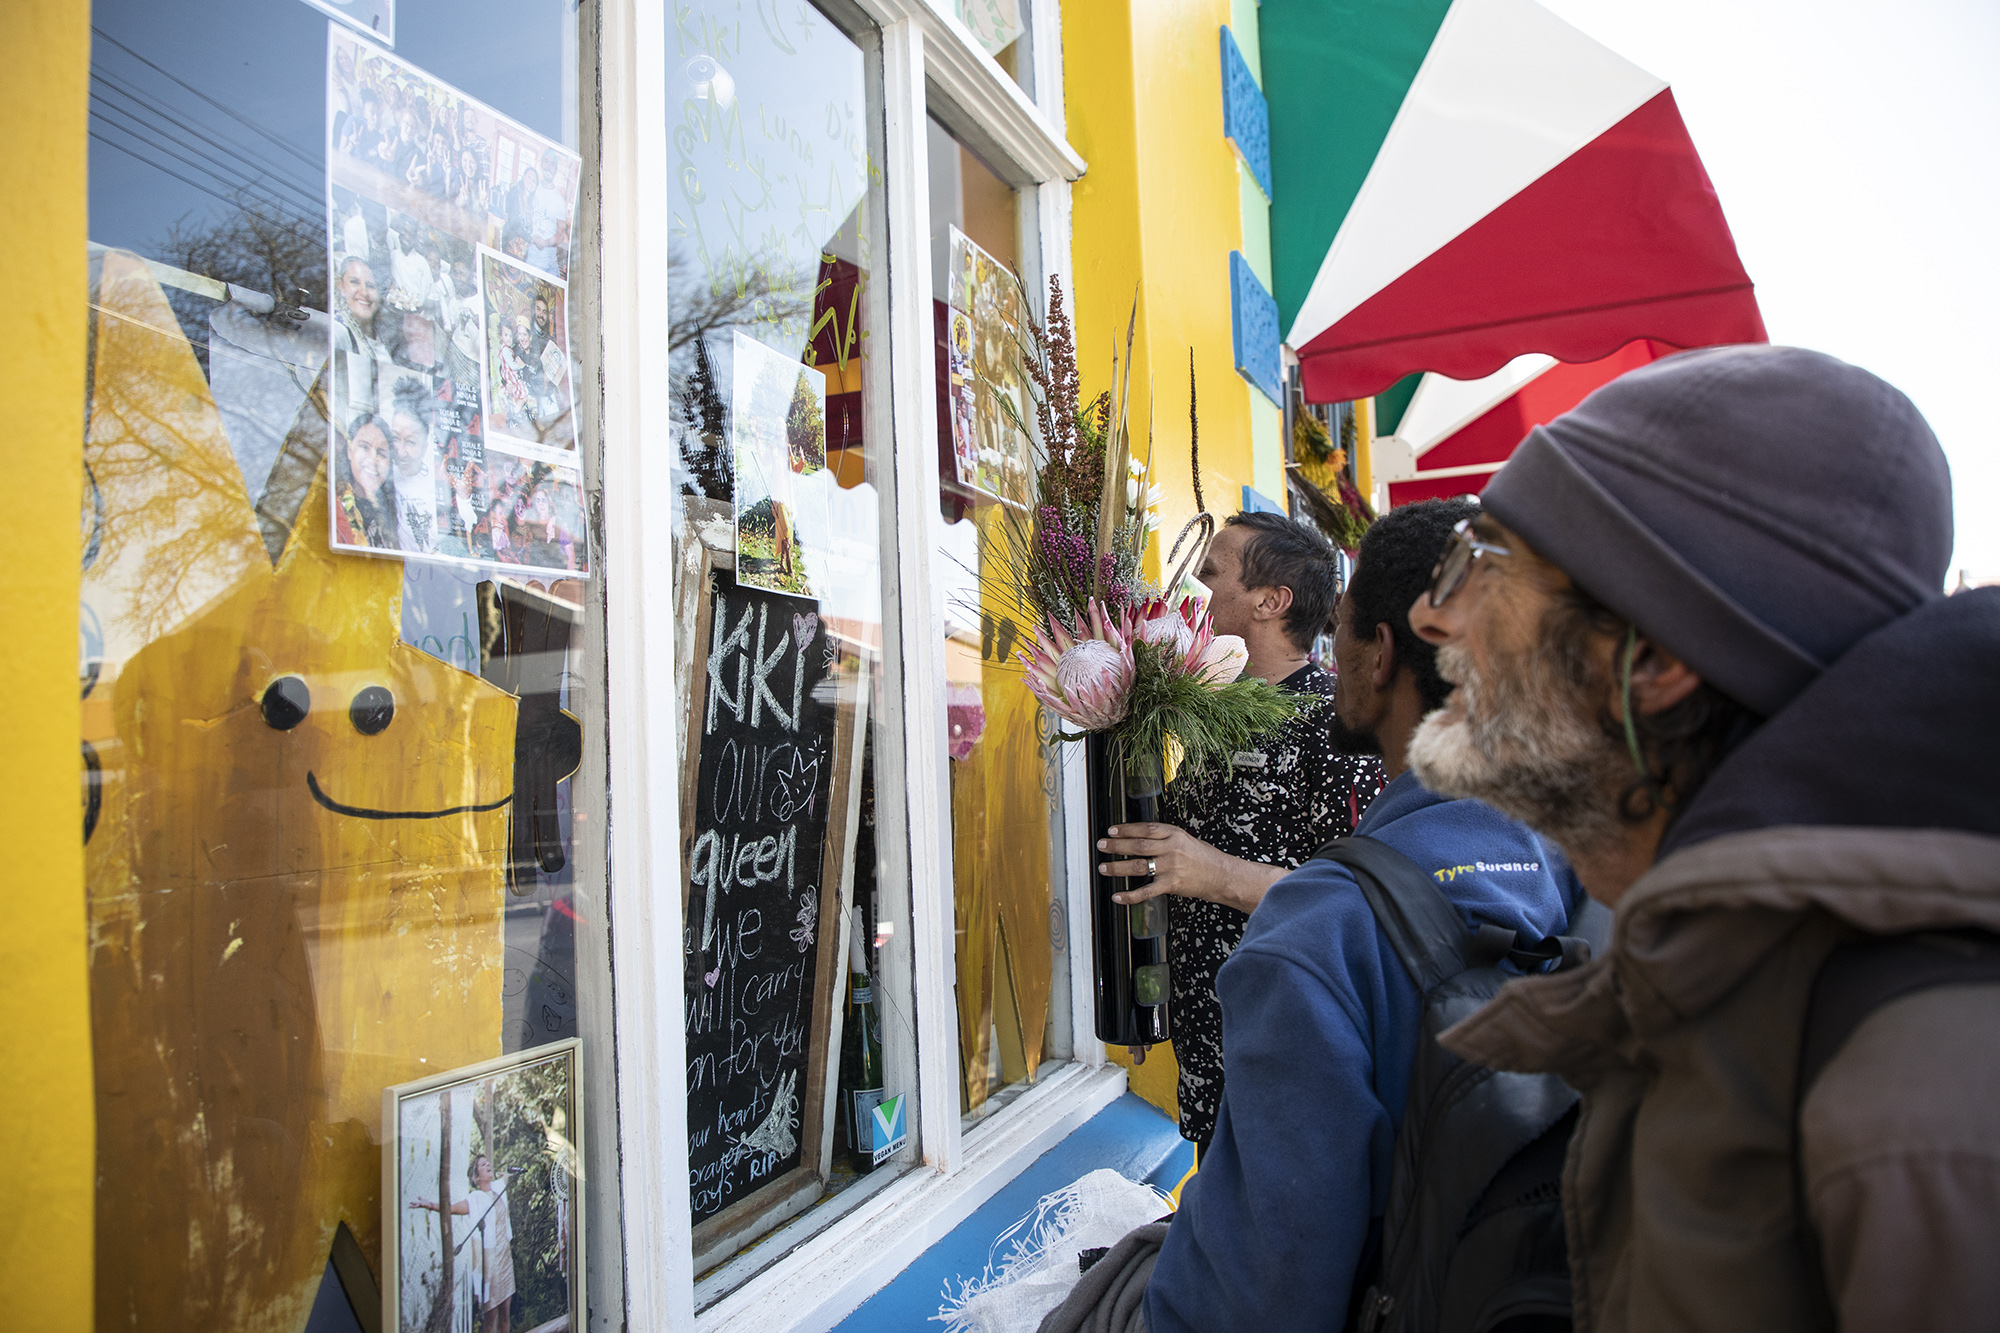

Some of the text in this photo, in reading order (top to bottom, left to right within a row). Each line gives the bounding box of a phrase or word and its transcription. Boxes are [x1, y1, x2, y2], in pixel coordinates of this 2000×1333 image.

[1434, 861, 1540, 882] TyreSurance
[716, 1086, 771, 1135] hearts
[874, 1138, 907, 1162] VEGAN MENU
